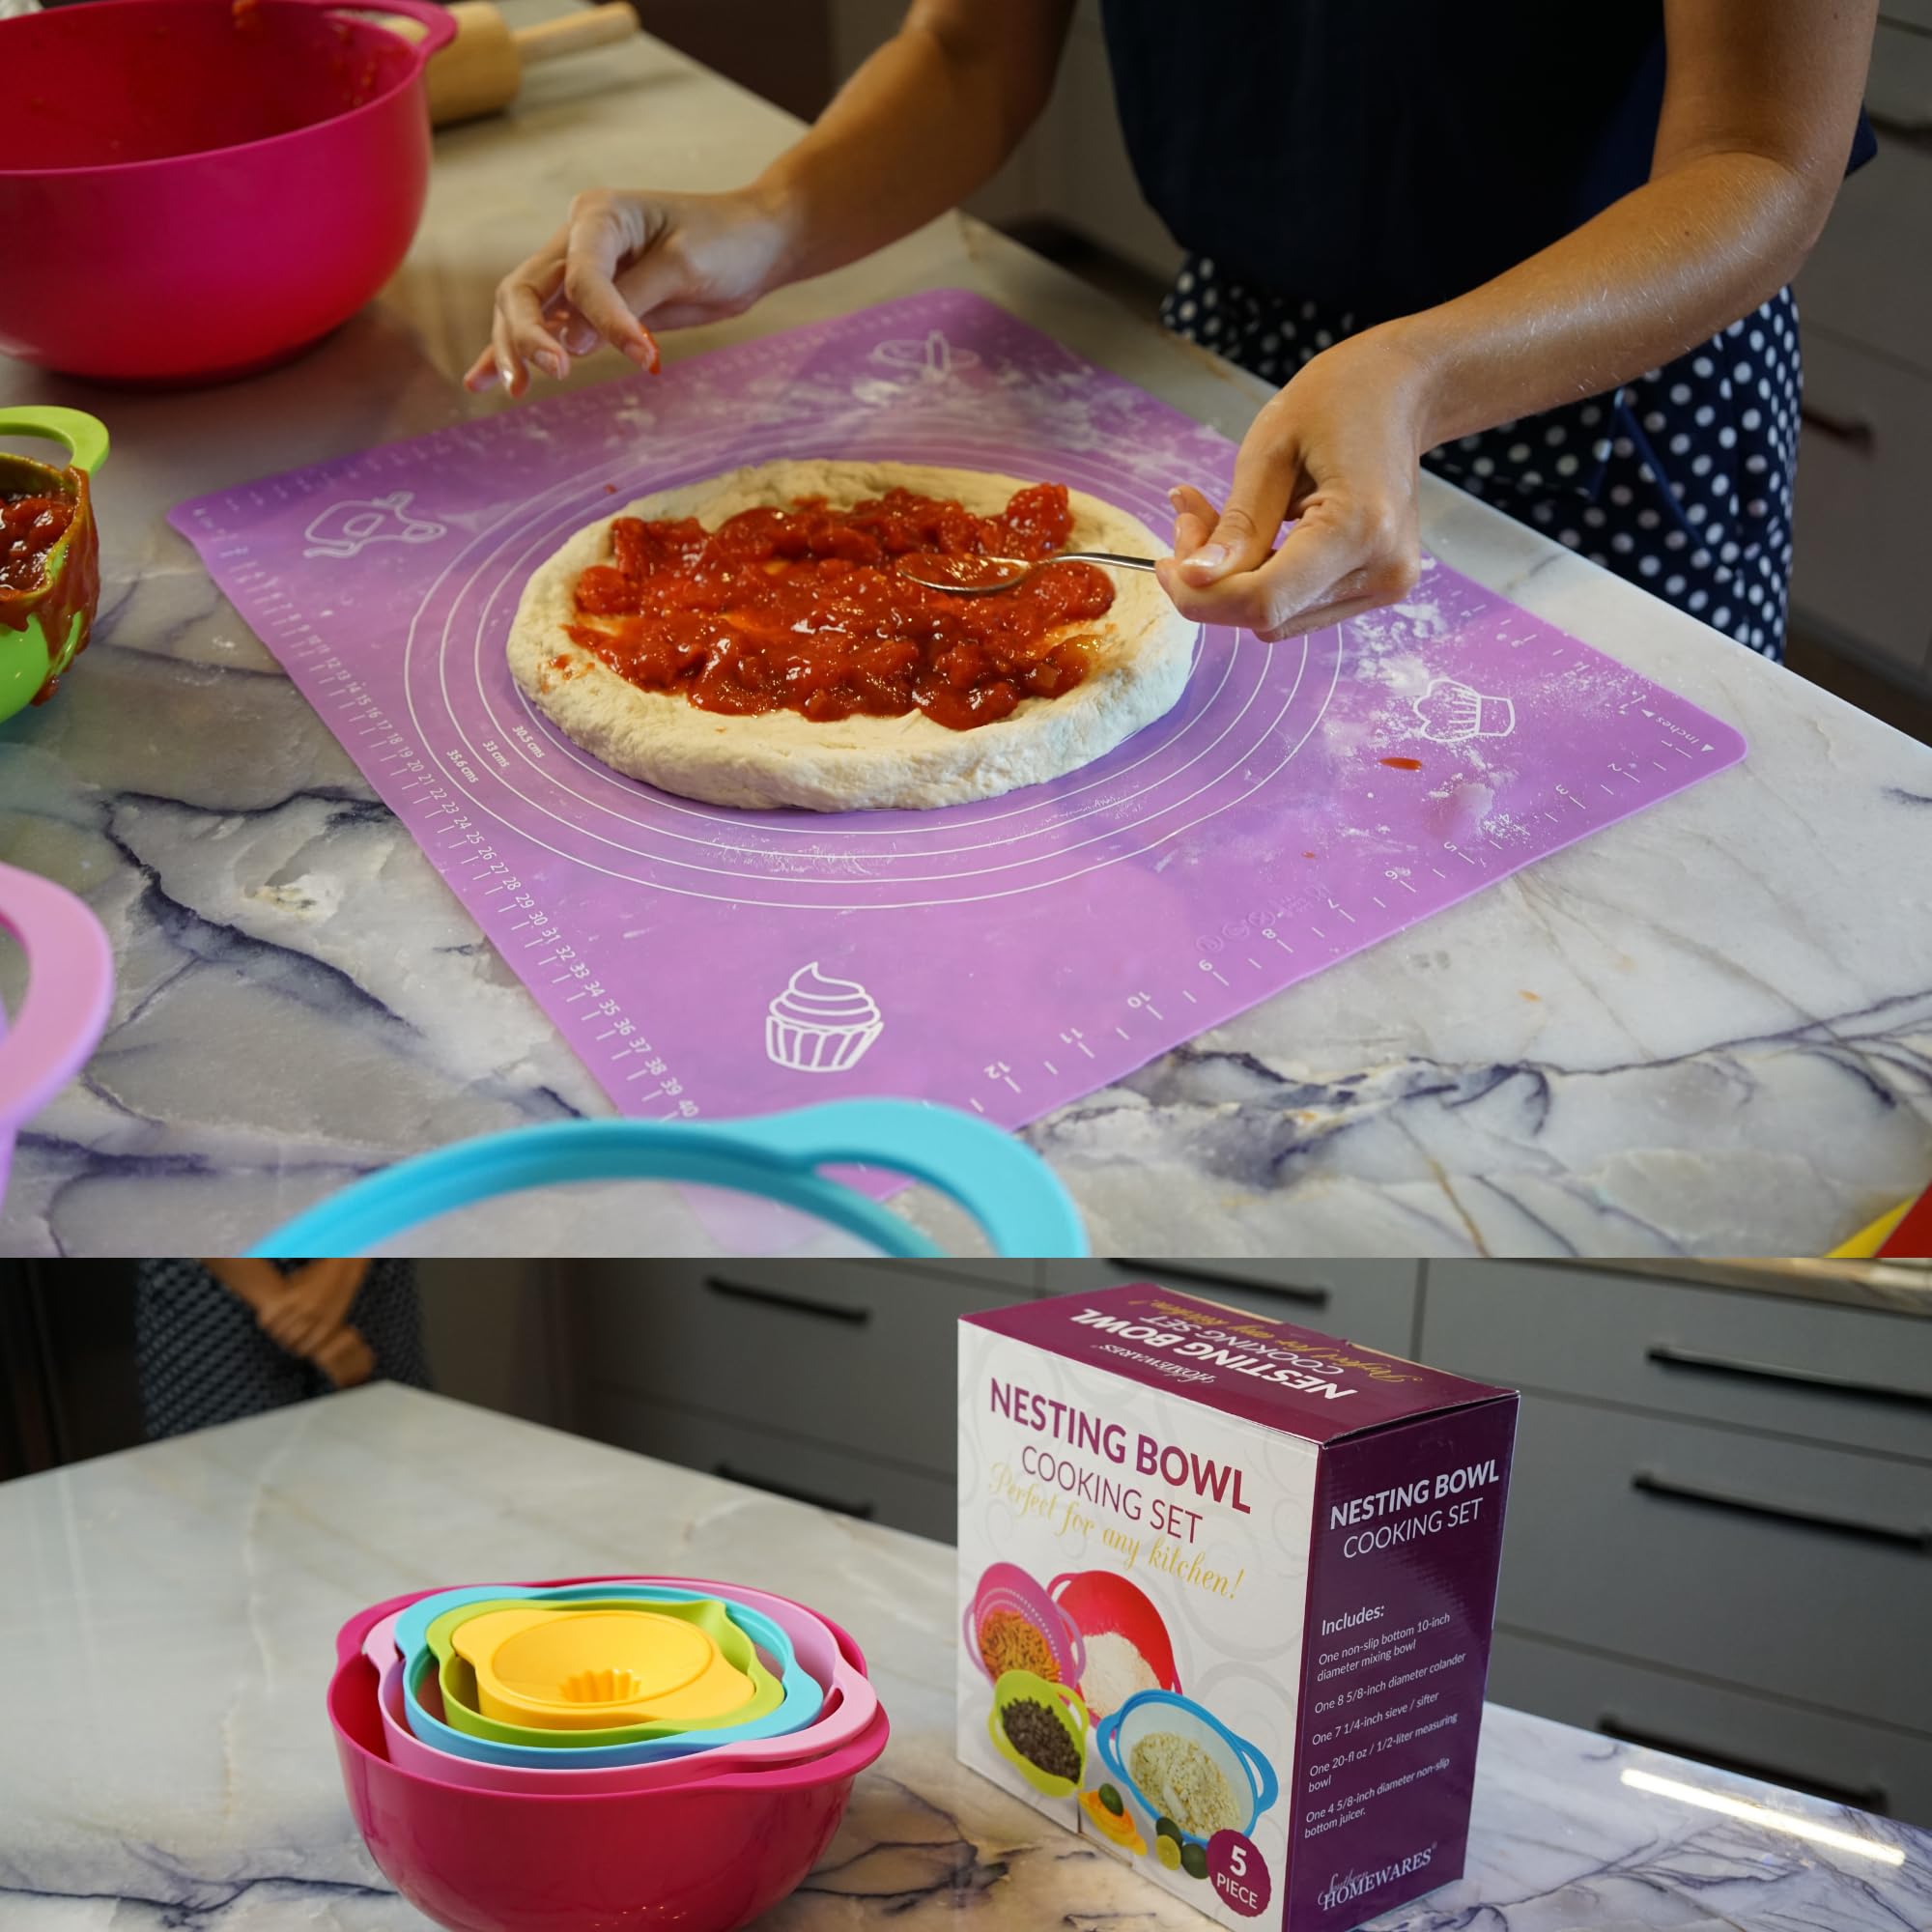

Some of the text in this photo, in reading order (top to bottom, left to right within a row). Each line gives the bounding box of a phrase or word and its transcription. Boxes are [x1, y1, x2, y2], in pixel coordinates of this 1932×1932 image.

[483, 740, 510, 767] 33 cms
[512, 725, 545, 757] 30.5 cms
[1661, 740, 1673, 749] 1
[446, 749, 479, 783] 35.6 cms
[1607, 763, 1622, 772] 2
[1555, 784, 1569, 795] 3
[1443, 841, 1458, 853] 5
[338, 670, 351, 681] 13
[349, 681, 361, 694] 14
[358, 695, 372, 706] 15
[366, 707, 384, 719] 16
[377, 720, 393, 730] 17
[387, 733, 404, 745] 18
[398, 746, 413, 758] 19
[407, 759, 425, 772] 20
[418, 773, 435, 785] 21
[430, 787, 447, 800] 22
[441, 801, 460, 814] 23
[453, 816, 471, 830] 24
[466, 831, 485, 844] 25
[477, 846, 497, 861] 26
[490, 862, 509, 874] 27
[502, 876, 522, 891] 28
[515, 893, 535, 909] 29
[528, 911, 549, 925] 30
[541, 926, 561, 944] 31
[555, 944, 576, 960] 32
[569, 962, 590, 979] 33
[584, 980, 606, 997] 34
[599, 999, 621, 1016] 35
[613, 1017, 637, 1036] 36
[629, 1037, 652, 1053] 37
[644, 1056, 668, 1075] 38
[660, 1077, 683, 1095] 39
[1384, 870, 1399, 880] 6
[1328, 898, 1340, 909] 7
[1262, 928, 1276, 940] 8
[1198, 959, 1213, 972] 9
[1127, 991, 1151, 1009] 10
[1060, 1028, 1083, 1043] 11
[984, 1062, 1010, 1080] 12
[1139, 1316, 1203, 1332] SET
[1069, 1309, 1358, 1400] NESTING BOWL
[1195, 1329, 1345, 1375] COOKING
[991, 1378, 1251, 1515] NESTING BOWL
[1022, 1445, 1203, 1543] COOKING SET
[1330, 1459, 1499, 1530] NESTING BOWL
[989, 1461, 1245, 1599] Perfect for any kitchen!
[1344, 1497, 1484, 1558] COOKING SET
[1321, 1605, 1385, 1636] Includes:
[1319, 1612, 1450, 1665] One non-slip bottom 10-inch
[1317, 1639, 1416, 1682] diameter mixing bowl
[1314, 1653, 1466, 1714] One 8 5/8-inch diameter colander
[1312, 1692, 1439, 1746] One 7 1/4-inch sieve / sifter
[1310, 1713, 1459, 1777] One 20-fl oz / 1/2-liter measuring
[1306, 1757, 1450, 1823] One 4 5/8-inch diameter non-slip
[1308, 1775, 1332, 1793] bowl
[1304, 1807, 1366, 1838] bottom juicer.
[1229, 1844, 1247, 1877] 5
[1216, 1872, 1259, 1910] PIECE
[1322, 1847, 1433, 1912] HOMEWARES
